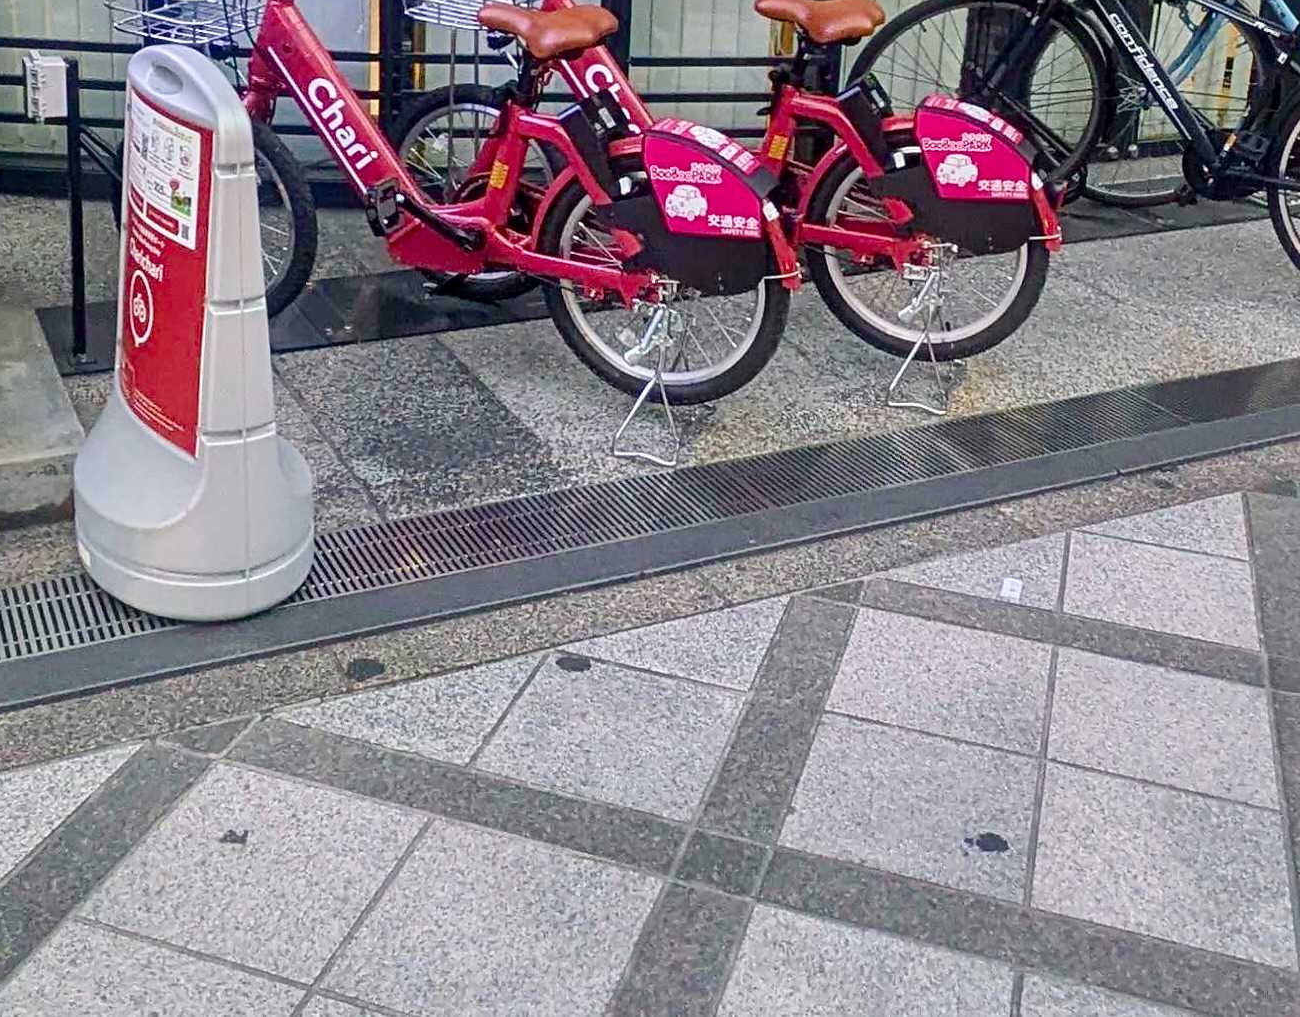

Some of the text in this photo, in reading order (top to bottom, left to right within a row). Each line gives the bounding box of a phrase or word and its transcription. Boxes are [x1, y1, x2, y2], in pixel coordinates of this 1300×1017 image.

[1109, 13, 1179, 110] confidence
[308, 78, 378, 170] Chari
[978, 179, 1028, 192] 交通安全
[708, 214, 759, 230] 交通安全
